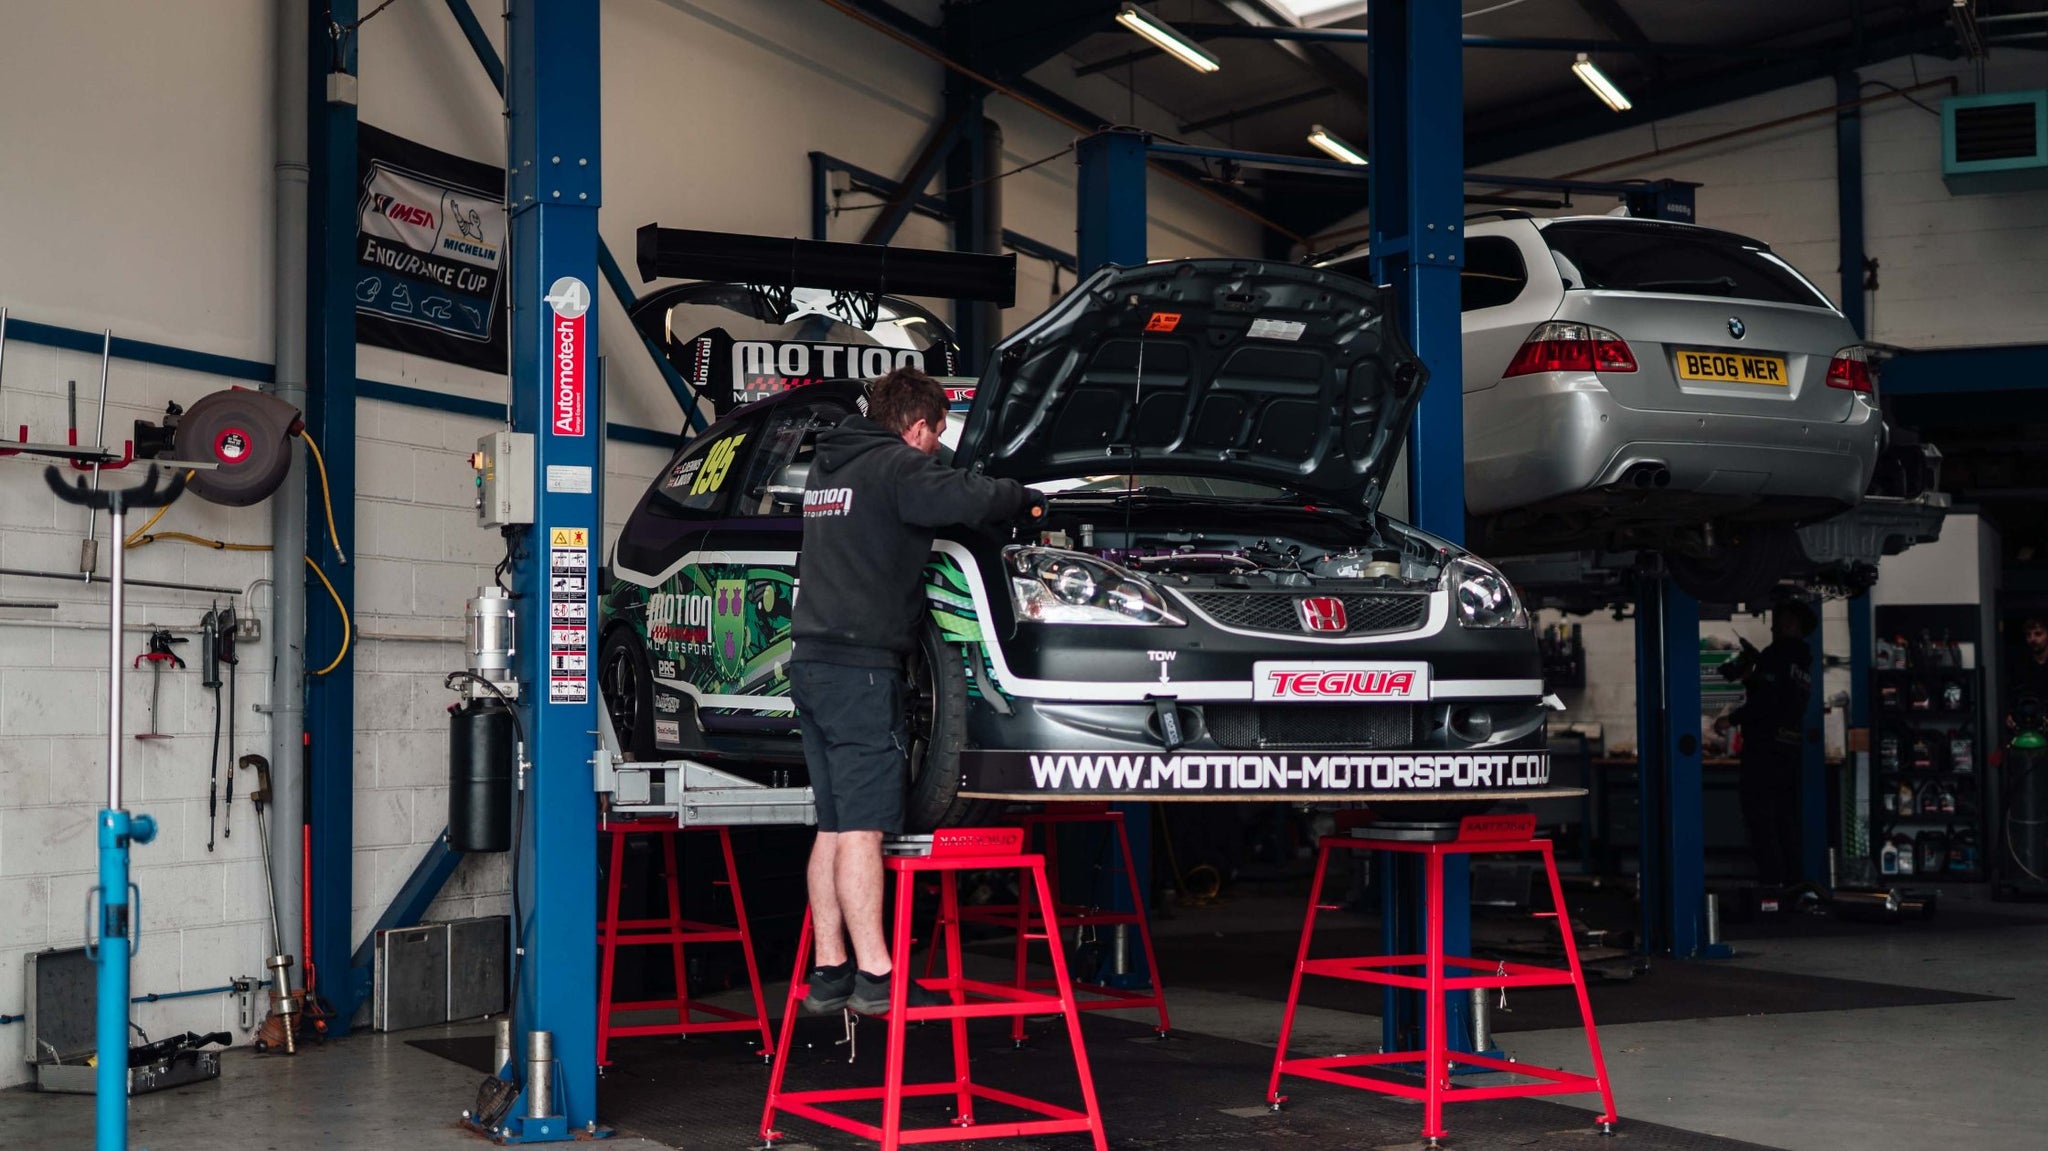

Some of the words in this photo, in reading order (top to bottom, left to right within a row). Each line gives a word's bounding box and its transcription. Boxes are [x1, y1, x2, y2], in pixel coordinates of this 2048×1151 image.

[388, 203, 435, 230] IMSA
[363, 240, 456, 286] ENDURANCE
[456, 266, 488, 293] CUP
[443, 238, 497, 261] MICHELIN
[556, 321, 574, 432] Automotech
[694, 337, 712, 385] MOTION
[731, 341, 925, 390] MOTION
[1686, 354, 1739, 377] BE06
[1742, 358, 1779, 380] MER
[689, 433, 747, 496] 195
[647, 594, 713, 643] MOTION
[646, 640, 713, 656] MOTORSPORT
[1147, 651, 1176, 661] TOW
[1268, 669, 1416, 698] TEGIWA
[1030, 755, 1550, 789] WWW.MOTION-MOTORSPORT.CO.U
